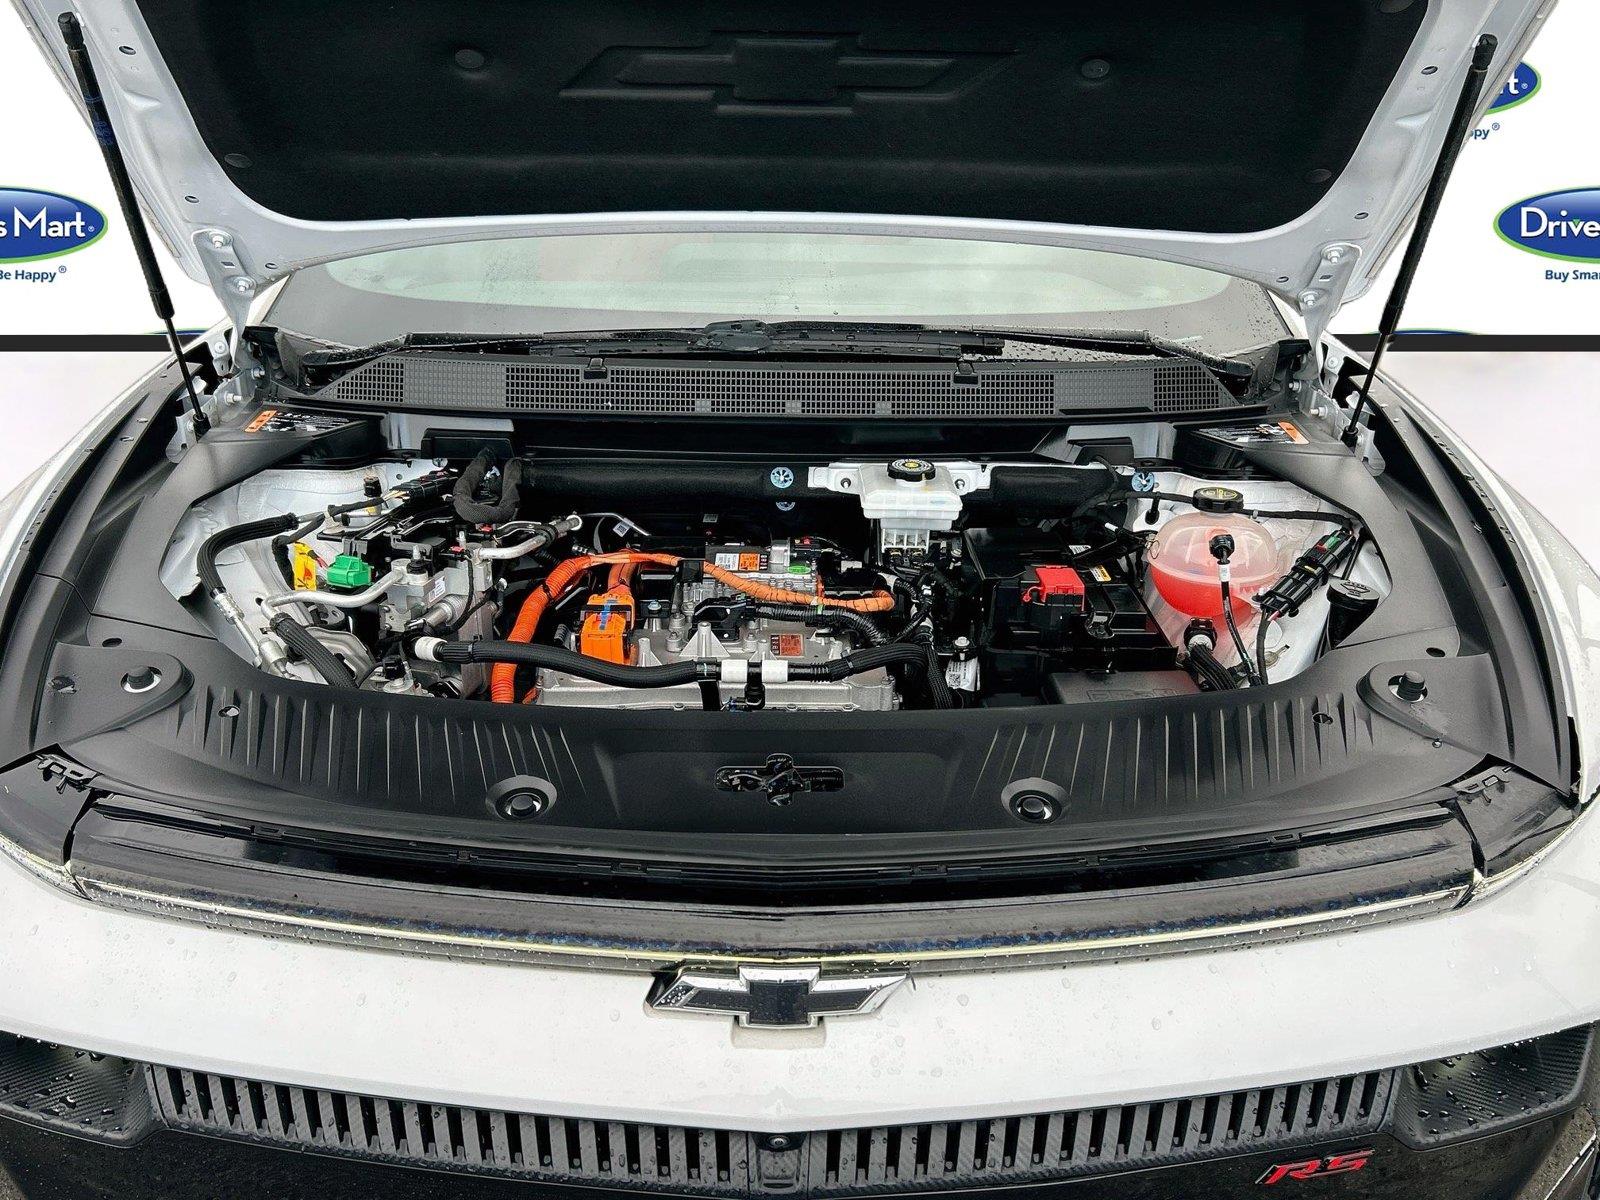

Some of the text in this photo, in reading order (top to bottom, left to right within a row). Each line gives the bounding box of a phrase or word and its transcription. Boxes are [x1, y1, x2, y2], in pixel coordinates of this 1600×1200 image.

[14, 206, 86, 237] Mart
[15, 269, 57, 283] Happy
[1545, 269, 1600, 283] Buy Sma
[1254, 1149, 1375, 1185] RS
